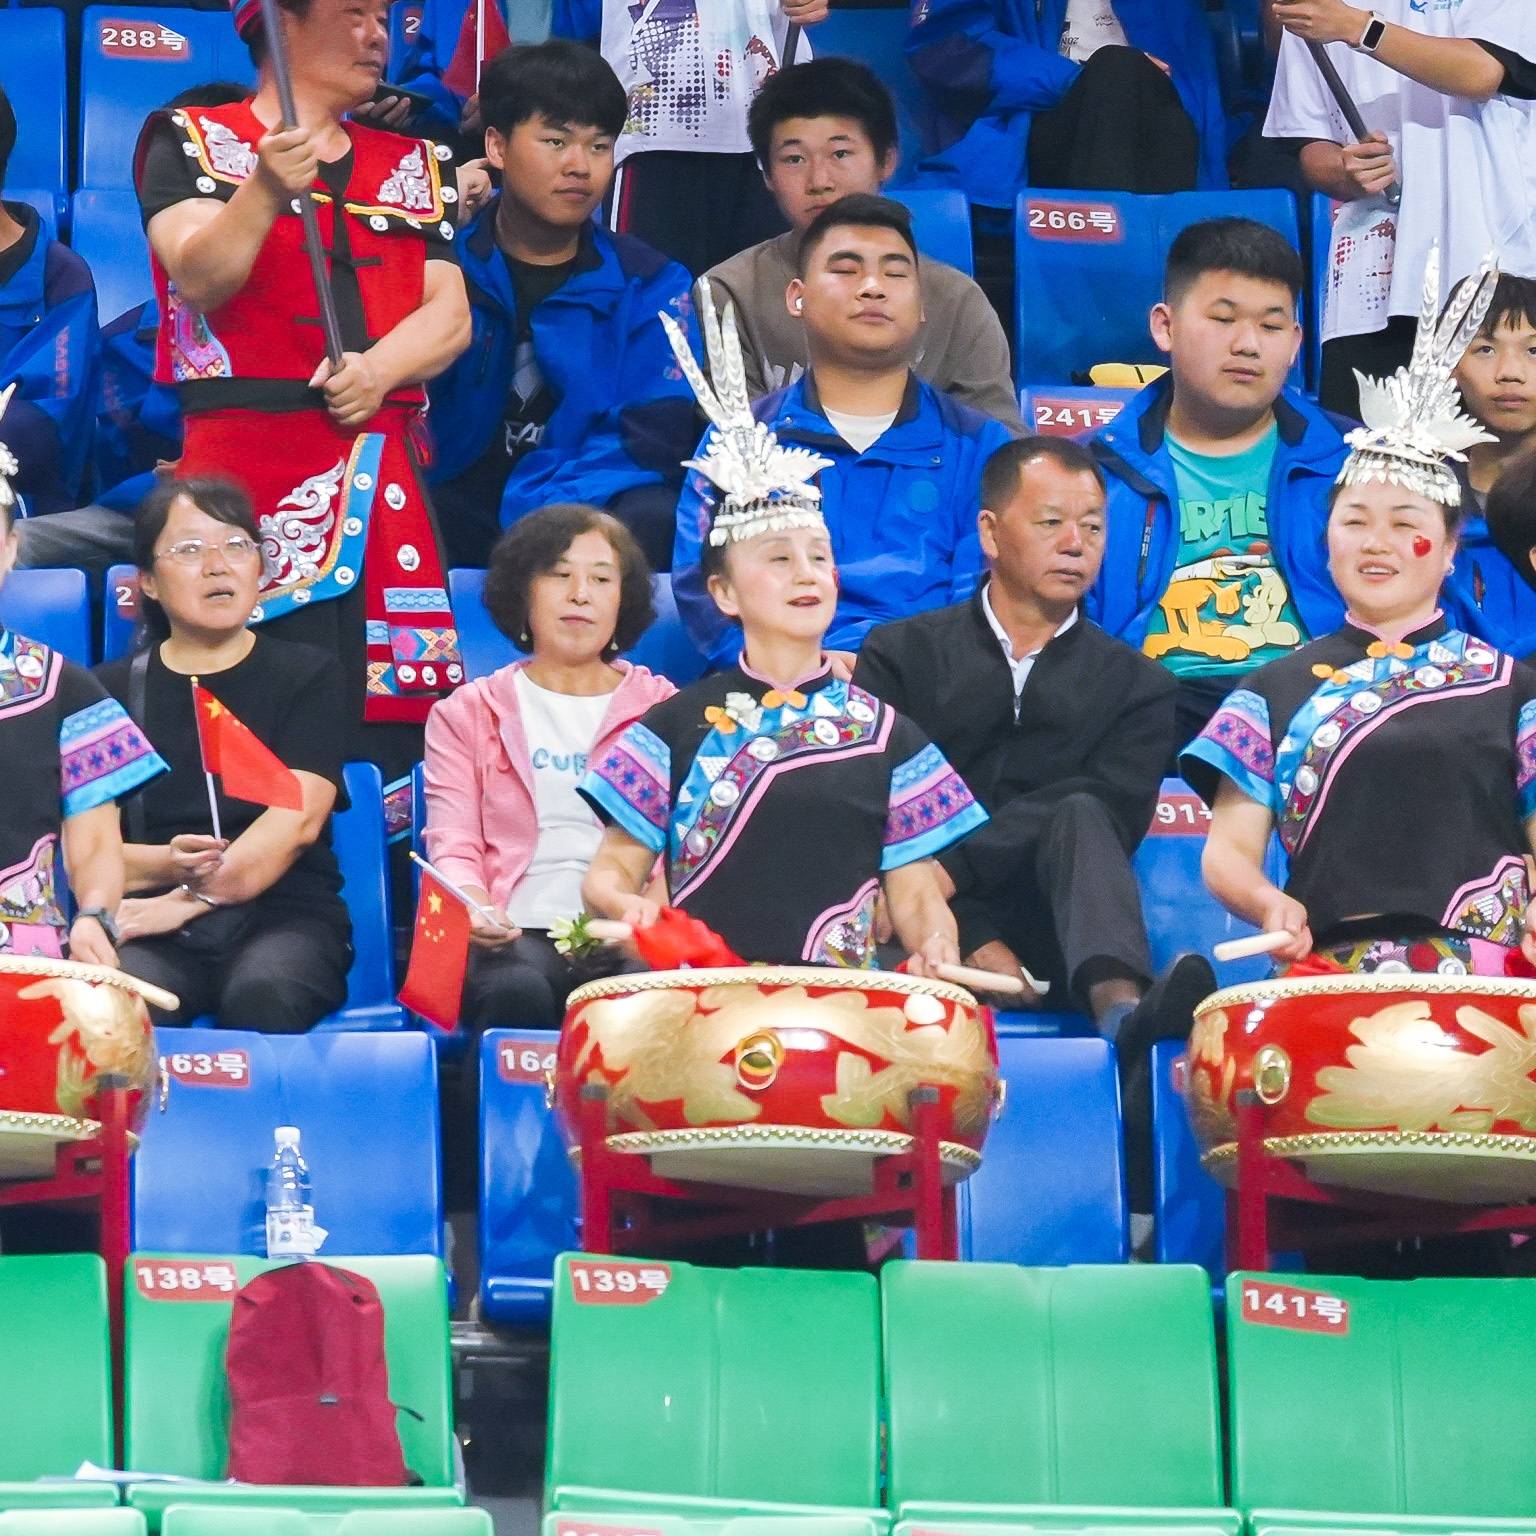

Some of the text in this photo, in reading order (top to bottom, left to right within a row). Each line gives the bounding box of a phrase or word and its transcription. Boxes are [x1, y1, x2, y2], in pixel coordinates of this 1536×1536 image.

[102, 26, 186, 52] 288号
[1028, 208, 1117, 234] 266号
[137, 1265, 236, 1292] 138号
[573, 1267, 670, 1296] 139号
[1244, 1287, 1347, 1325] 141号
